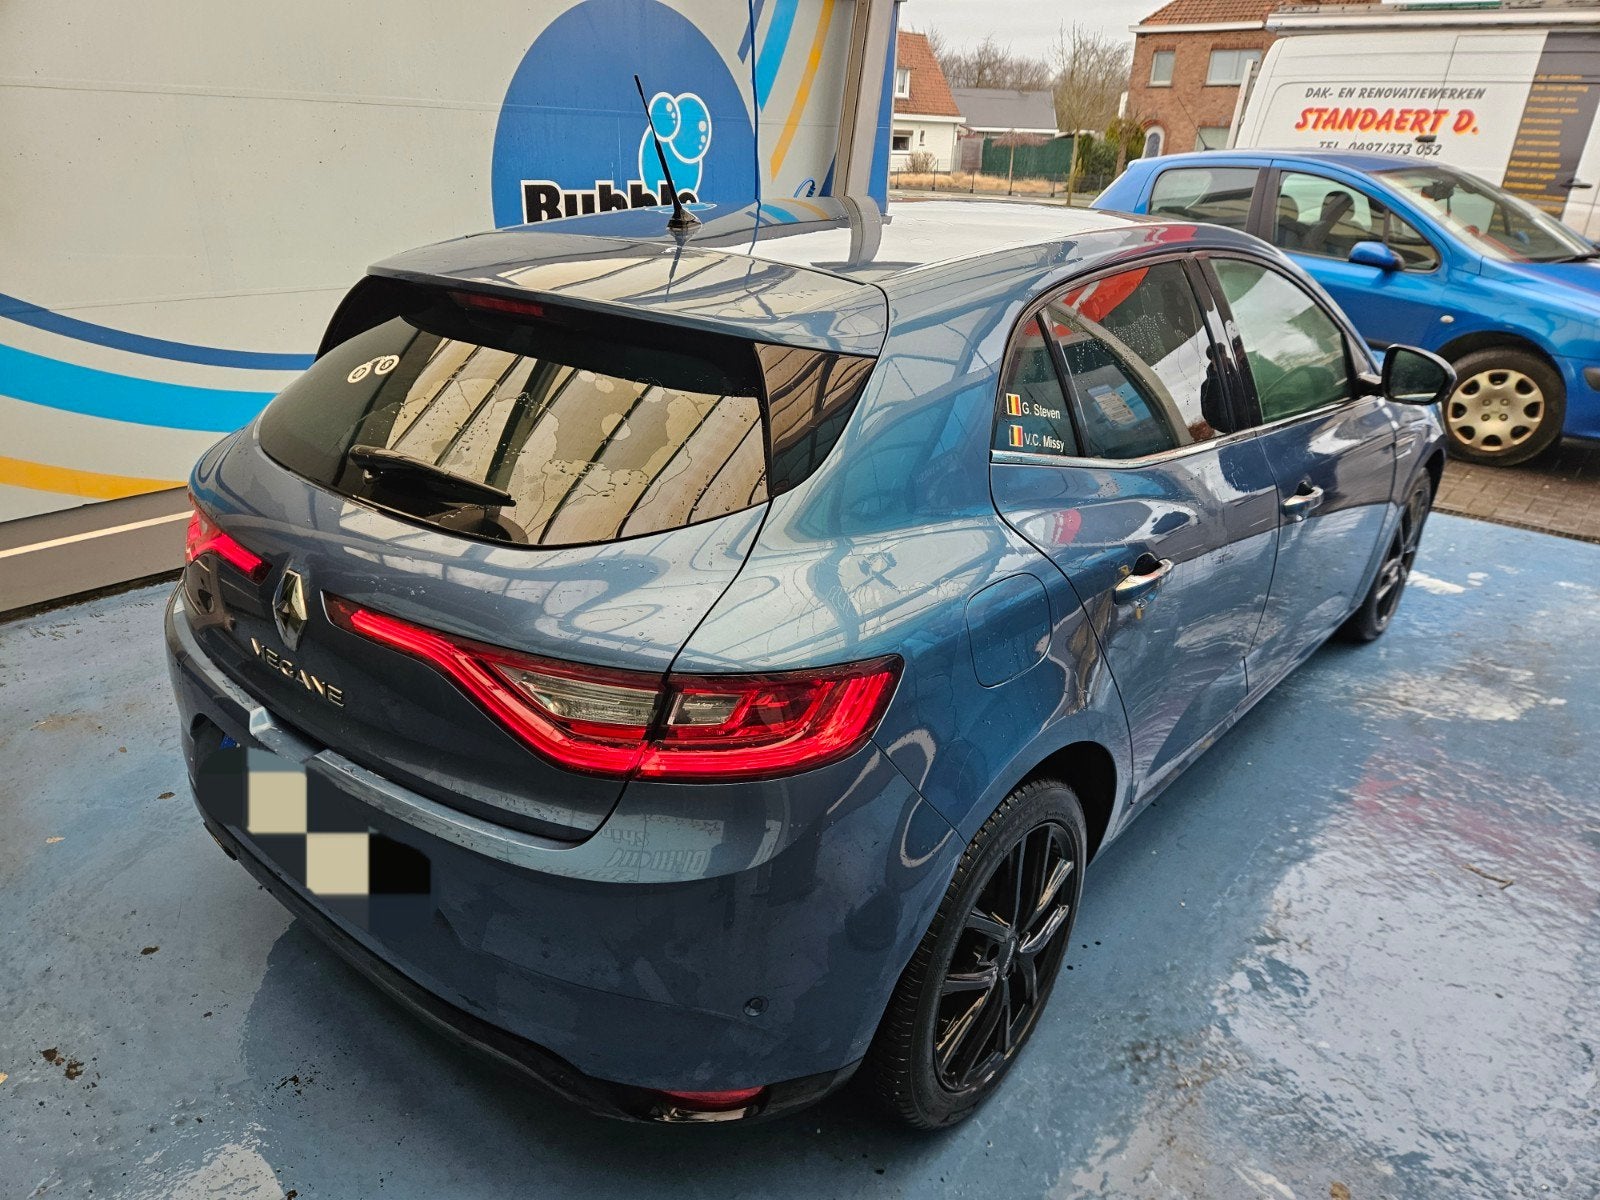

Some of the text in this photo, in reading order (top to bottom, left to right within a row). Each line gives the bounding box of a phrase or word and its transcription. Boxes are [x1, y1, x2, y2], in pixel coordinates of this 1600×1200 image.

[1305, 87, 1487, 101] DAK- EN RENOVATIEWERKEN
[1294, 106, 1480, 136] STANDAERT D.
[1416, 143, 1442, 156] 052
[1021, 401, 1061, 420] G. Steven
[1024, 432, 1065, 453] V.C. Missy
[251, 637, 345, 708] MEGANE
